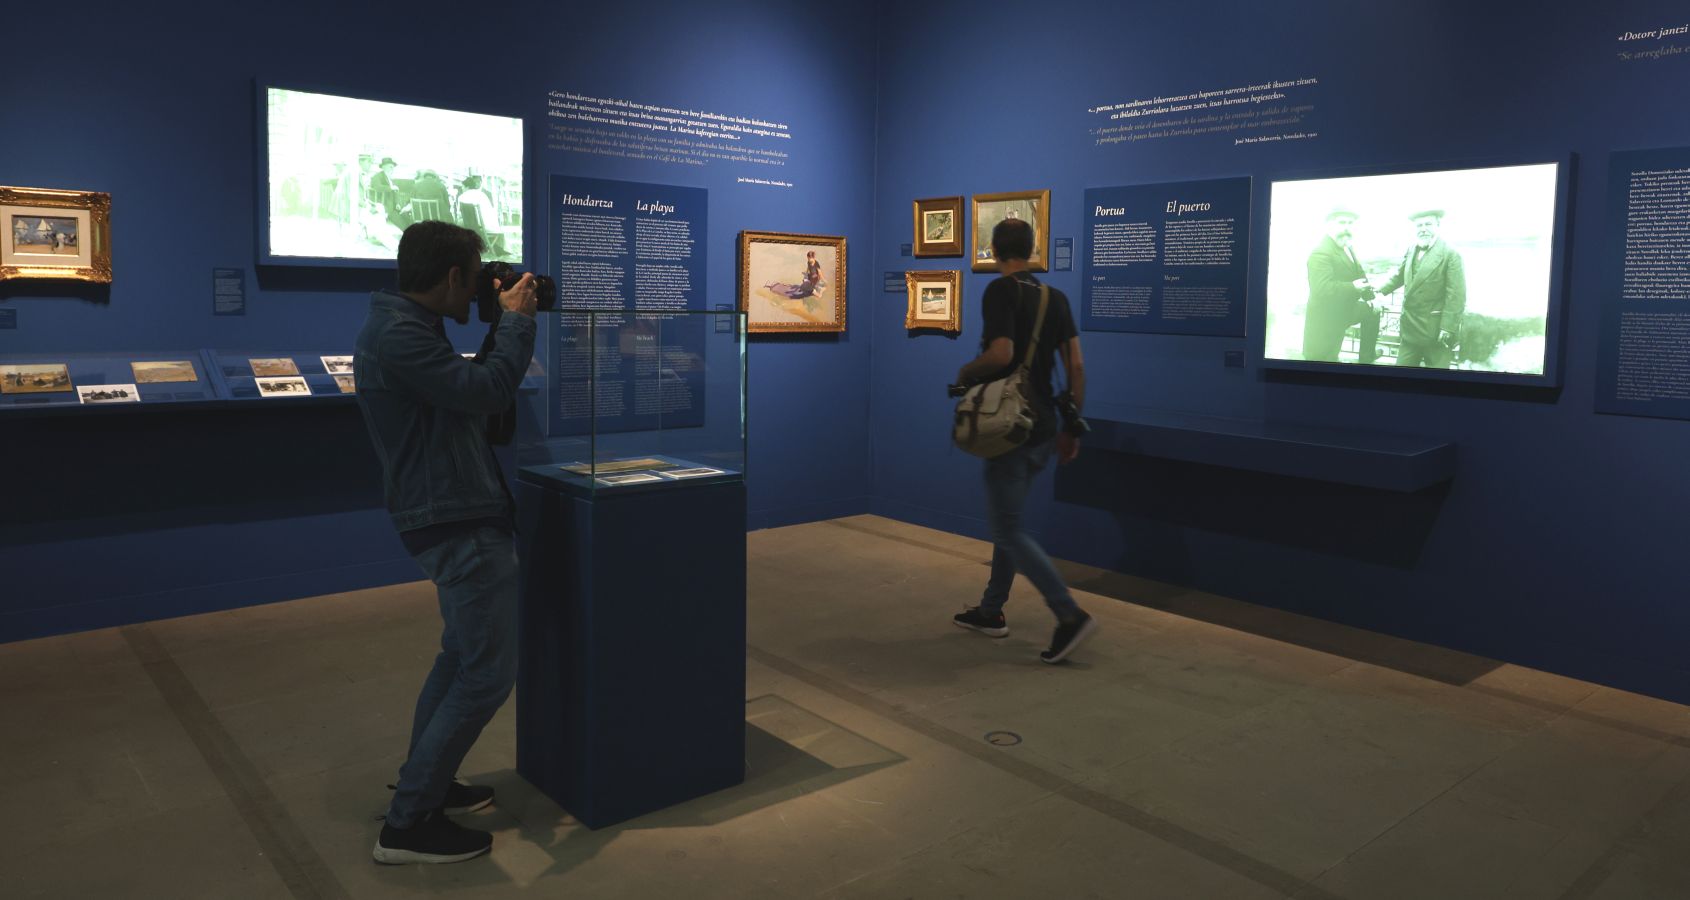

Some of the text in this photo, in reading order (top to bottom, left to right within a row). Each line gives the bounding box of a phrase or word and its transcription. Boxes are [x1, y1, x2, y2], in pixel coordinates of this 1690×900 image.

[1657, 24, 1689, 40] jantzi
[562, 194, 613, 208] Hondartza
[637, 199, 674, 215] La playa
[1166, 200, 1210, 216] El puerto
[1095, 205, 1125, 216] Portua
